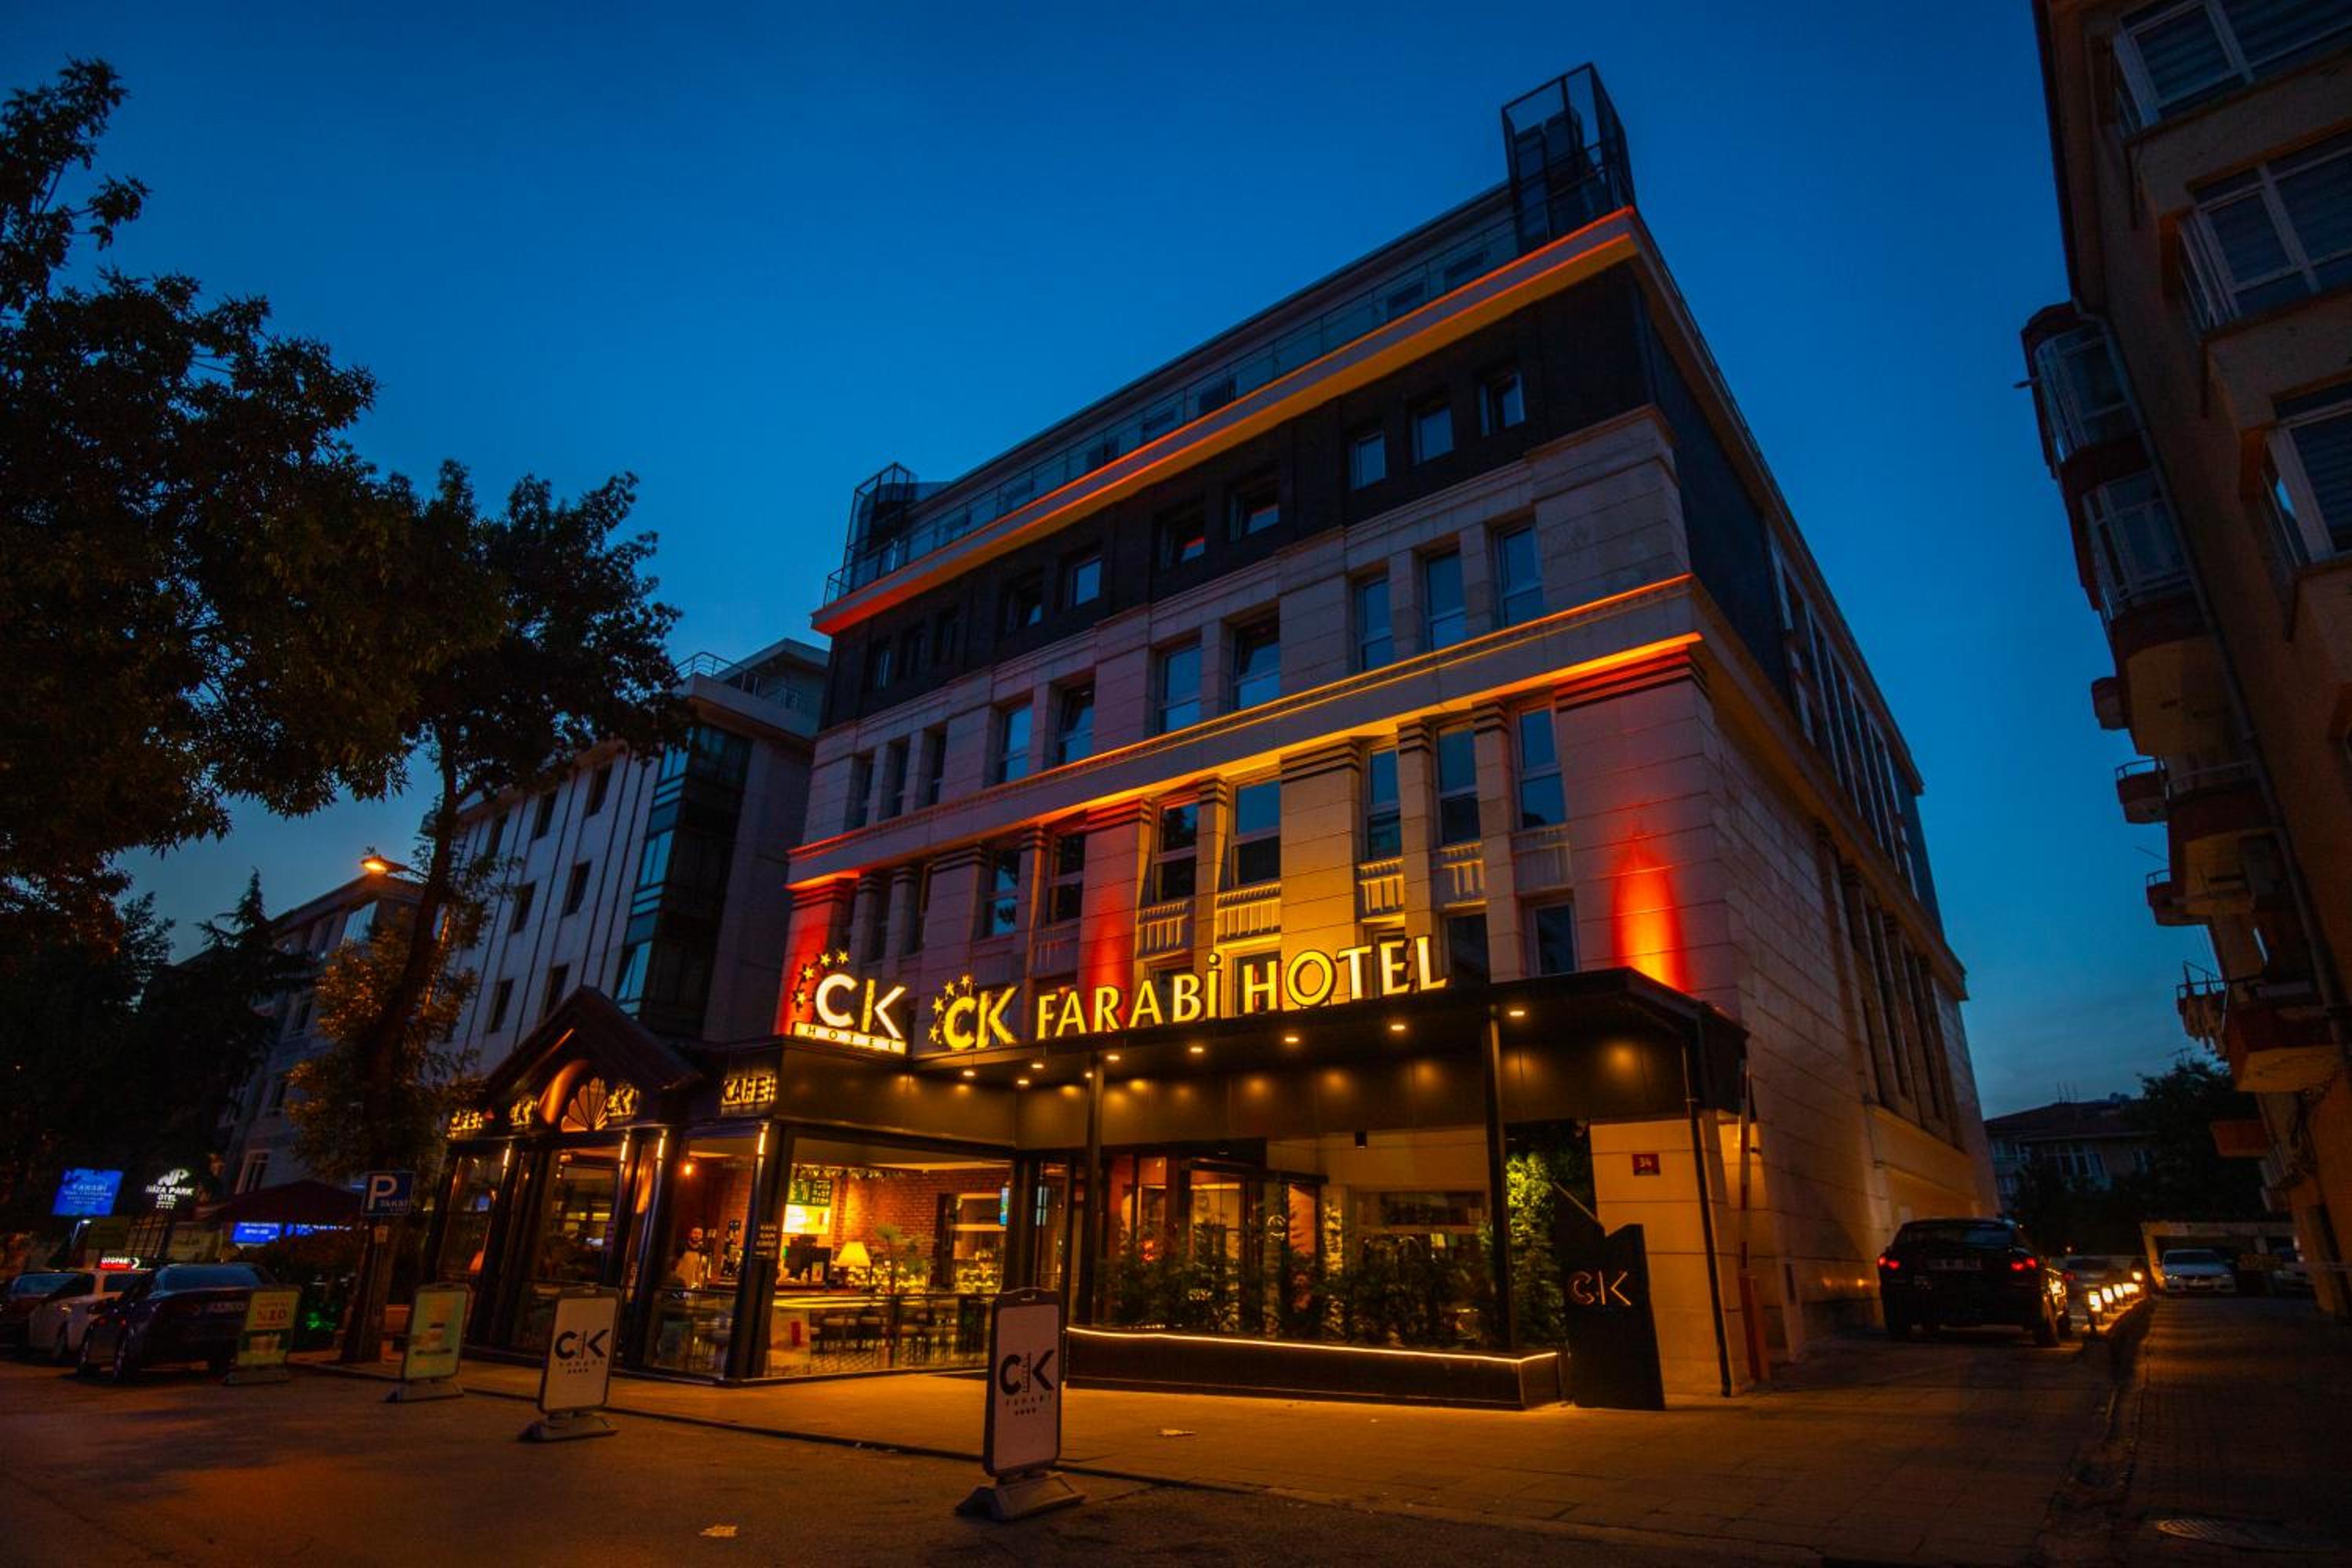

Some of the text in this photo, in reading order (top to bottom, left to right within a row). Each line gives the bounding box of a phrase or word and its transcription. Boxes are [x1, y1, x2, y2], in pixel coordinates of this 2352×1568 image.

[816, 973, 906, 1040] CK
[943, 986, 1018, 1049] CK
[1243, 936, 1447, 1014] HOTEL
[807, 1025, 893, 1050] HOTEL
[368, 1175, 397, 1210] P
[1573, 1270, 1632, 1305] CK
[555, 1330, 609, 1359] CK
[1000, 1349, 1054, 1396] CK
